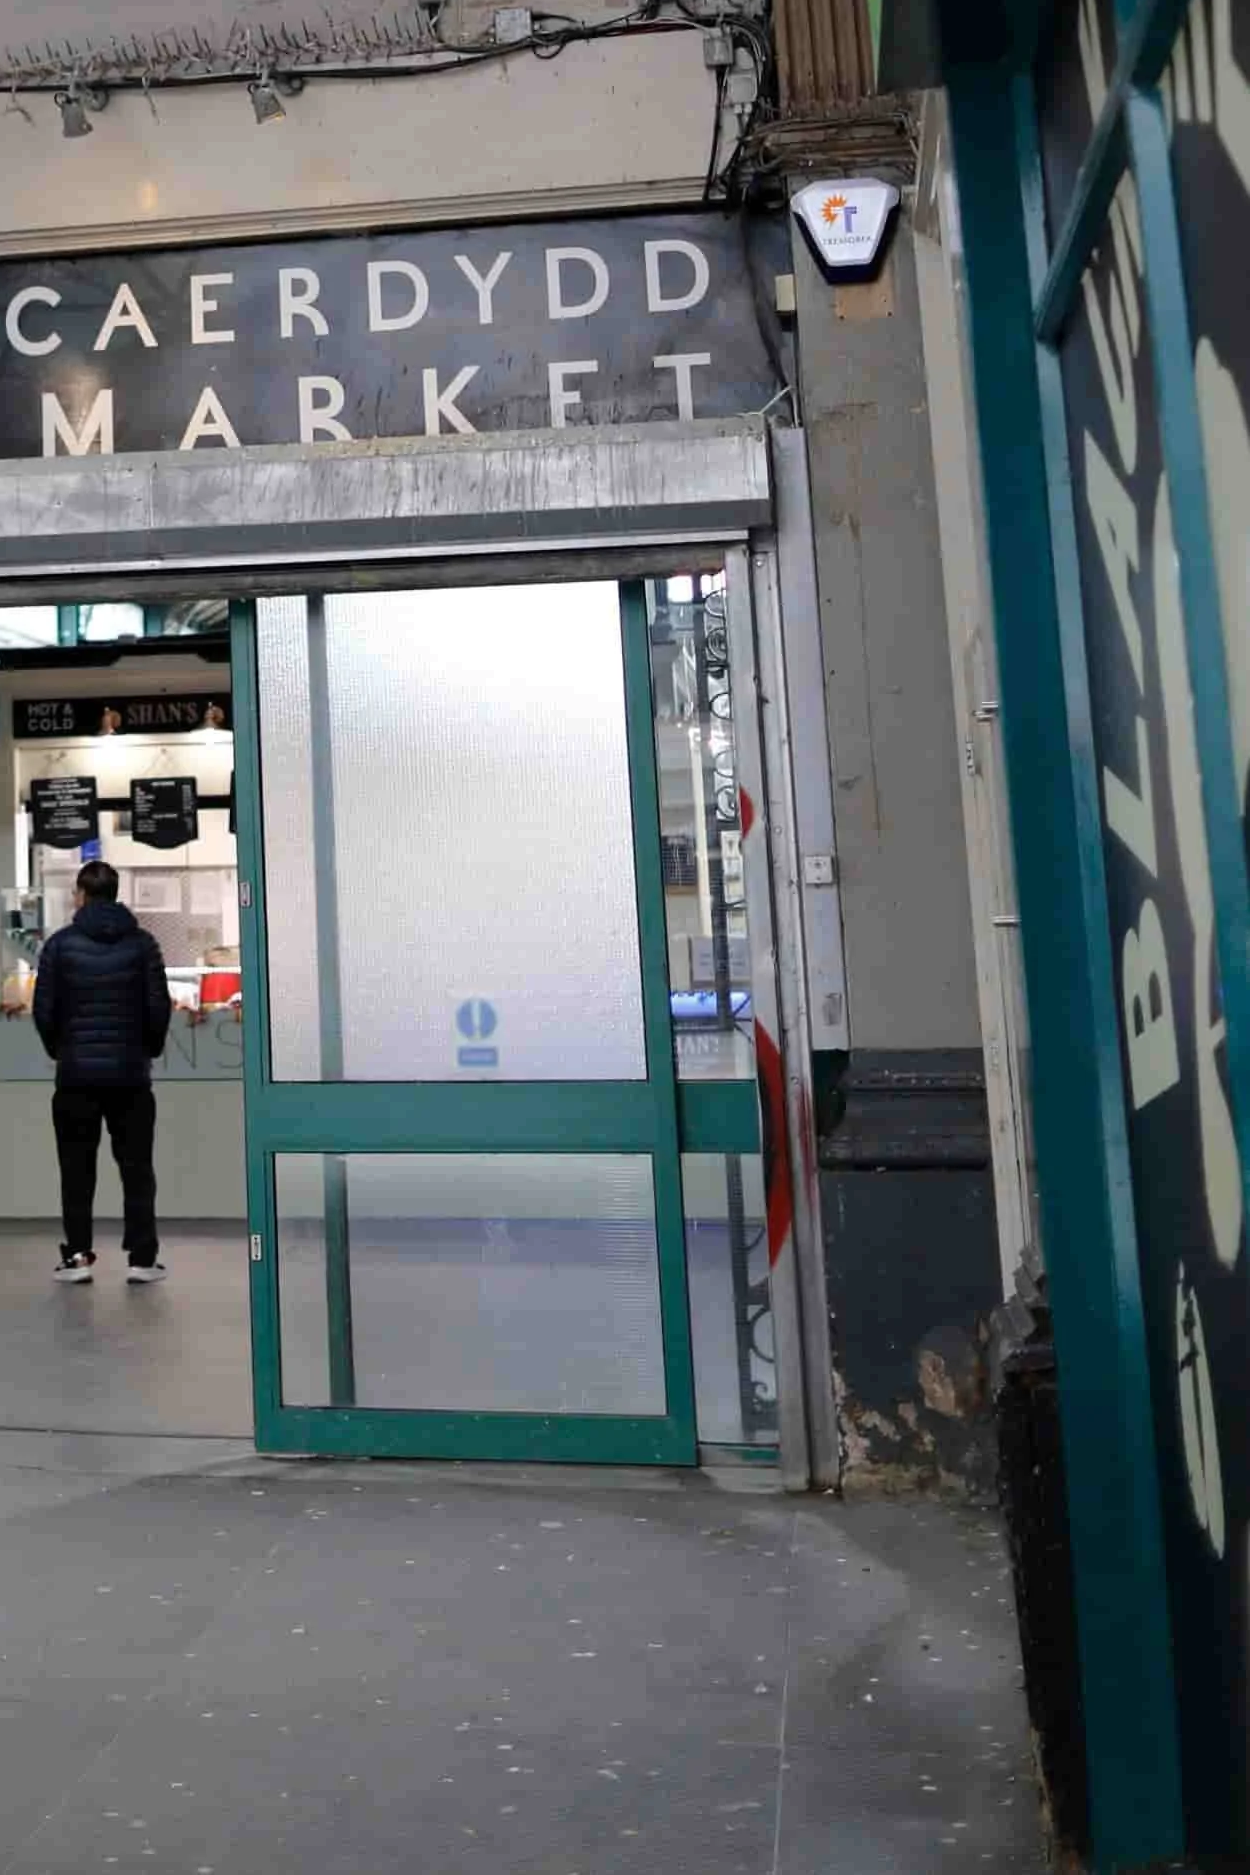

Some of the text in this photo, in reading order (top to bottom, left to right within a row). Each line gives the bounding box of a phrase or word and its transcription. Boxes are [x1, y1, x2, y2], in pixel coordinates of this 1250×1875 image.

[5, 238, 711, 357] CAERDYDD
[41, 352, 712, 457] MARKET
[27, 718, 75, 732] COLD
[28, 702, 57, 717] HOT
